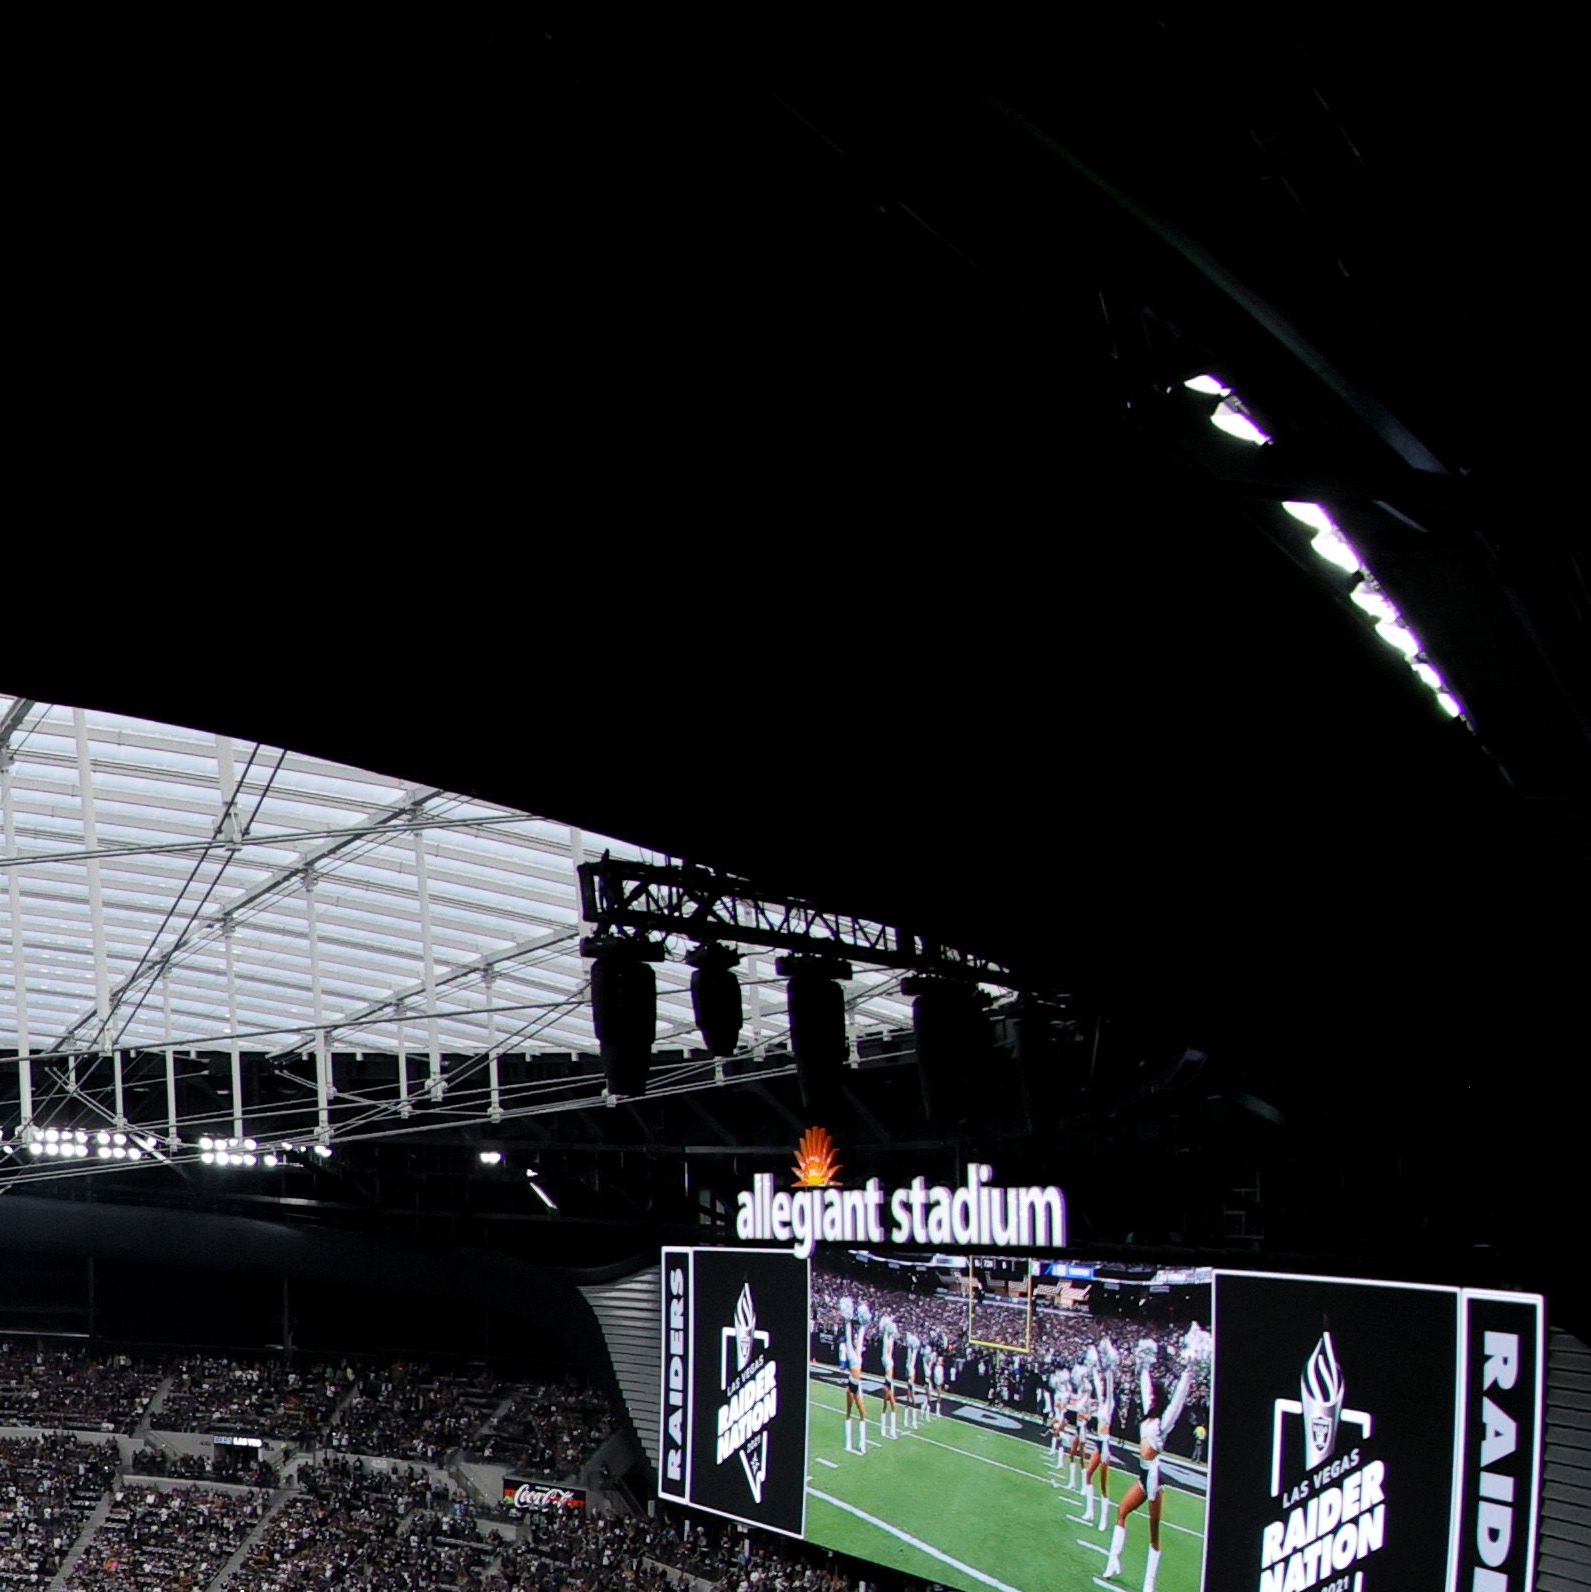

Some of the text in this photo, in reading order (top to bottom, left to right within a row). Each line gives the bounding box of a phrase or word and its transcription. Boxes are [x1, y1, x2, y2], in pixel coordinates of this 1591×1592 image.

[737, 1163, 1066, 1259] allegiant stadium
[667, 1268, 685, 1481] RAIDERS
[718, 1360, 777, 1436] RAIDER
[727, 1354, 764, 1397] LAS VEGAS
[717, 1386, 777, 1465] NATION
[1261, 1460, 1385, 1569] RAIDER
[1282, 1448, 1360, 1509] LAS VEGAS
